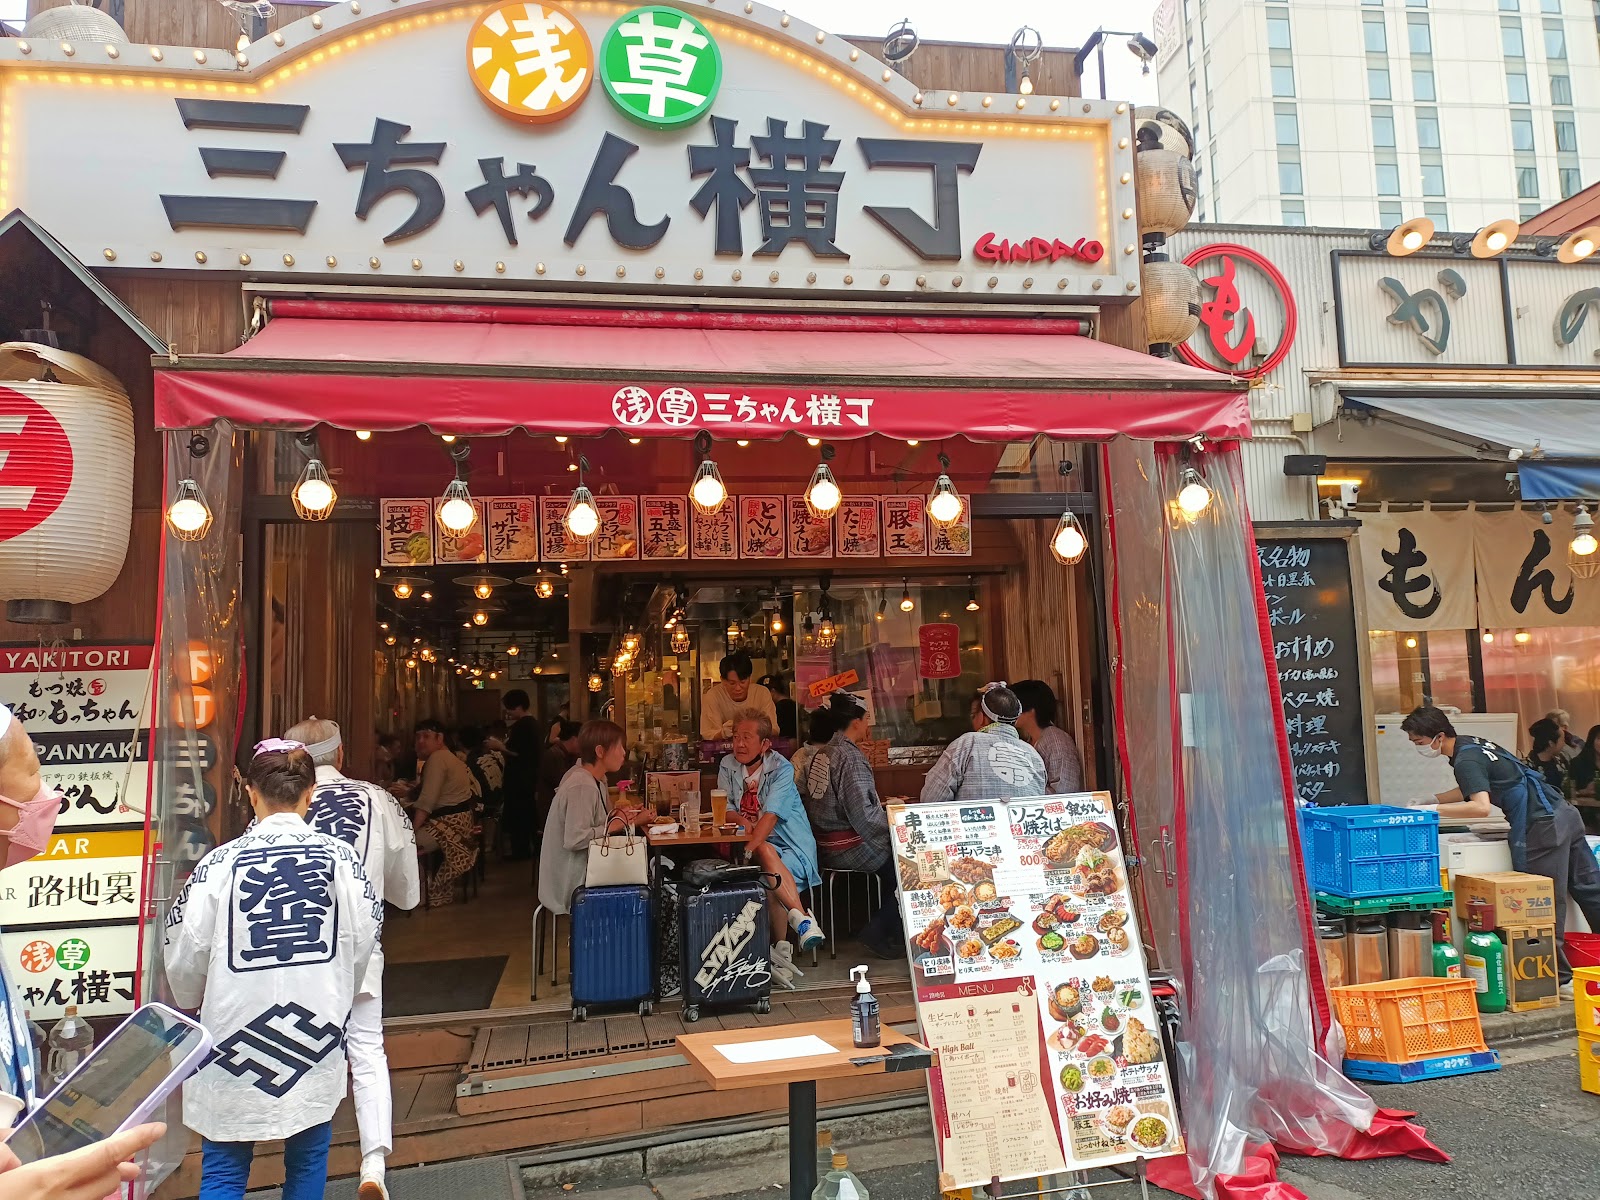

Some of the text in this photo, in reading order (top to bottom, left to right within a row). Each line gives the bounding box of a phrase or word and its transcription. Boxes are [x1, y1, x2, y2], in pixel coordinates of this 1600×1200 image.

[468, 2, 706, 119] 浅草
[159, 98, 982, 261] 三ちゃん横丁
[974, 232, 1104, 263] GINDACO
[908, 501, 921, 521] 鉄板
[385, 513, 413, 555] 枝豆
[648, 518, 668, 544] 五本
[843, 507, 860, 552] たこ焼
[1378, 528, 1575, 619] もん
[6, 650, 130, 668] YAKITORI
[1275, 635, 1335, 662] おすすめ
[29, 678, 87, 697] もつ焼
[813, 674, 855, 696] ホッピー
[1286, 713, 1329, 737] 料理
[42, 770, 114, 782] 下町の鉄板焼
[1012, 807, 1048, 823] ソース
[1389, 815, 1414, 824] カクヤス
[904, 811, 927, 859] 串焼き
[1023, 817, 1062, 836] 焼そば
[36, 838, 90, 856] AR
[957, 845, 1002, 857] 牛ハラミ串
[1020, 855, 1048, 866] 800円
[27, 871, 137, 908] 路地裏
[240, 857, 333, 962] 浅草
[1526, 897, 1552, 907] ラムネ
[21, 938, 90, 972] 浅草
[17, 970, 145, 1007] ゃん横丁
[958, 983, 995, 996] MENU
[928, 1011, 961, 1023] 生ビール
[942, 1042, 975, 1054] High Ball
[1120, 1063, 1160, 1078] ポテトサラダ
[1075, 1086, 1133, 1110] お好み焼
